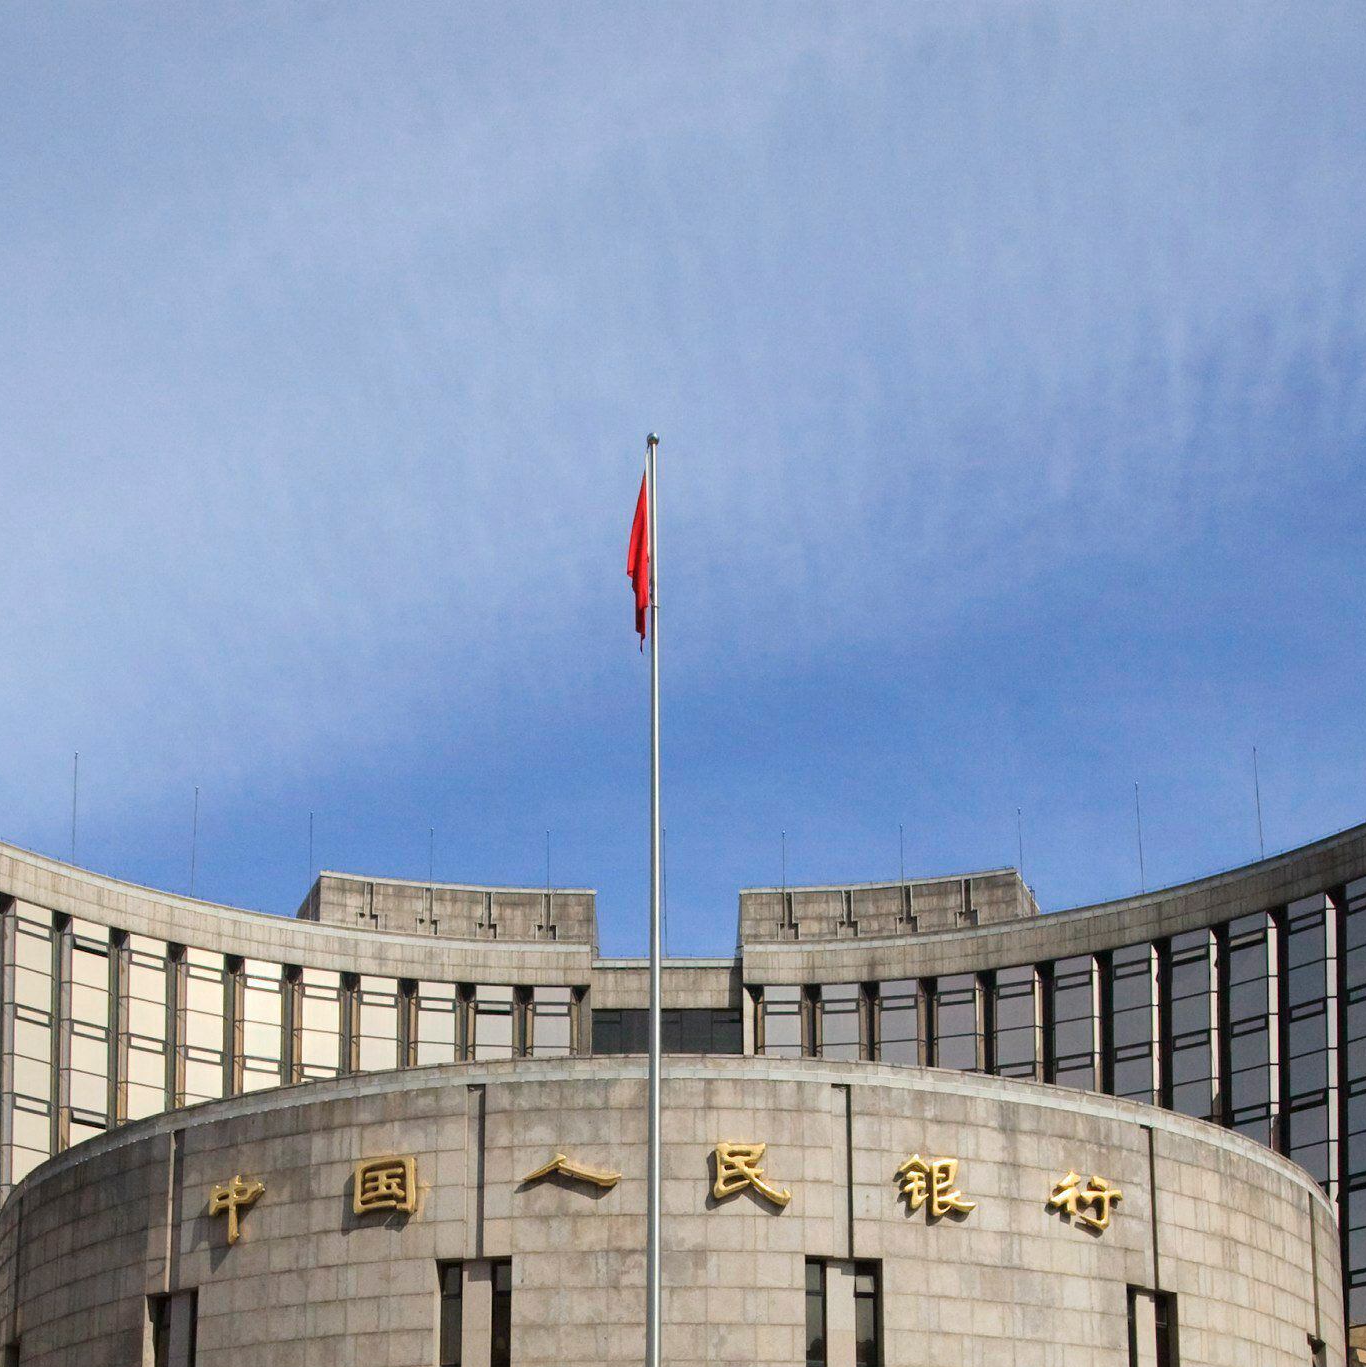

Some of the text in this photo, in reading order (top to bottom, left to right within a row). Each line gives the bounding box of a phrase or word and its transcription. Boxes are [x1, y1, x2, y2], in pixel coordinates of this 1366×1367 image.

[209, 1142, 1123, 1245] 中国人民银行
